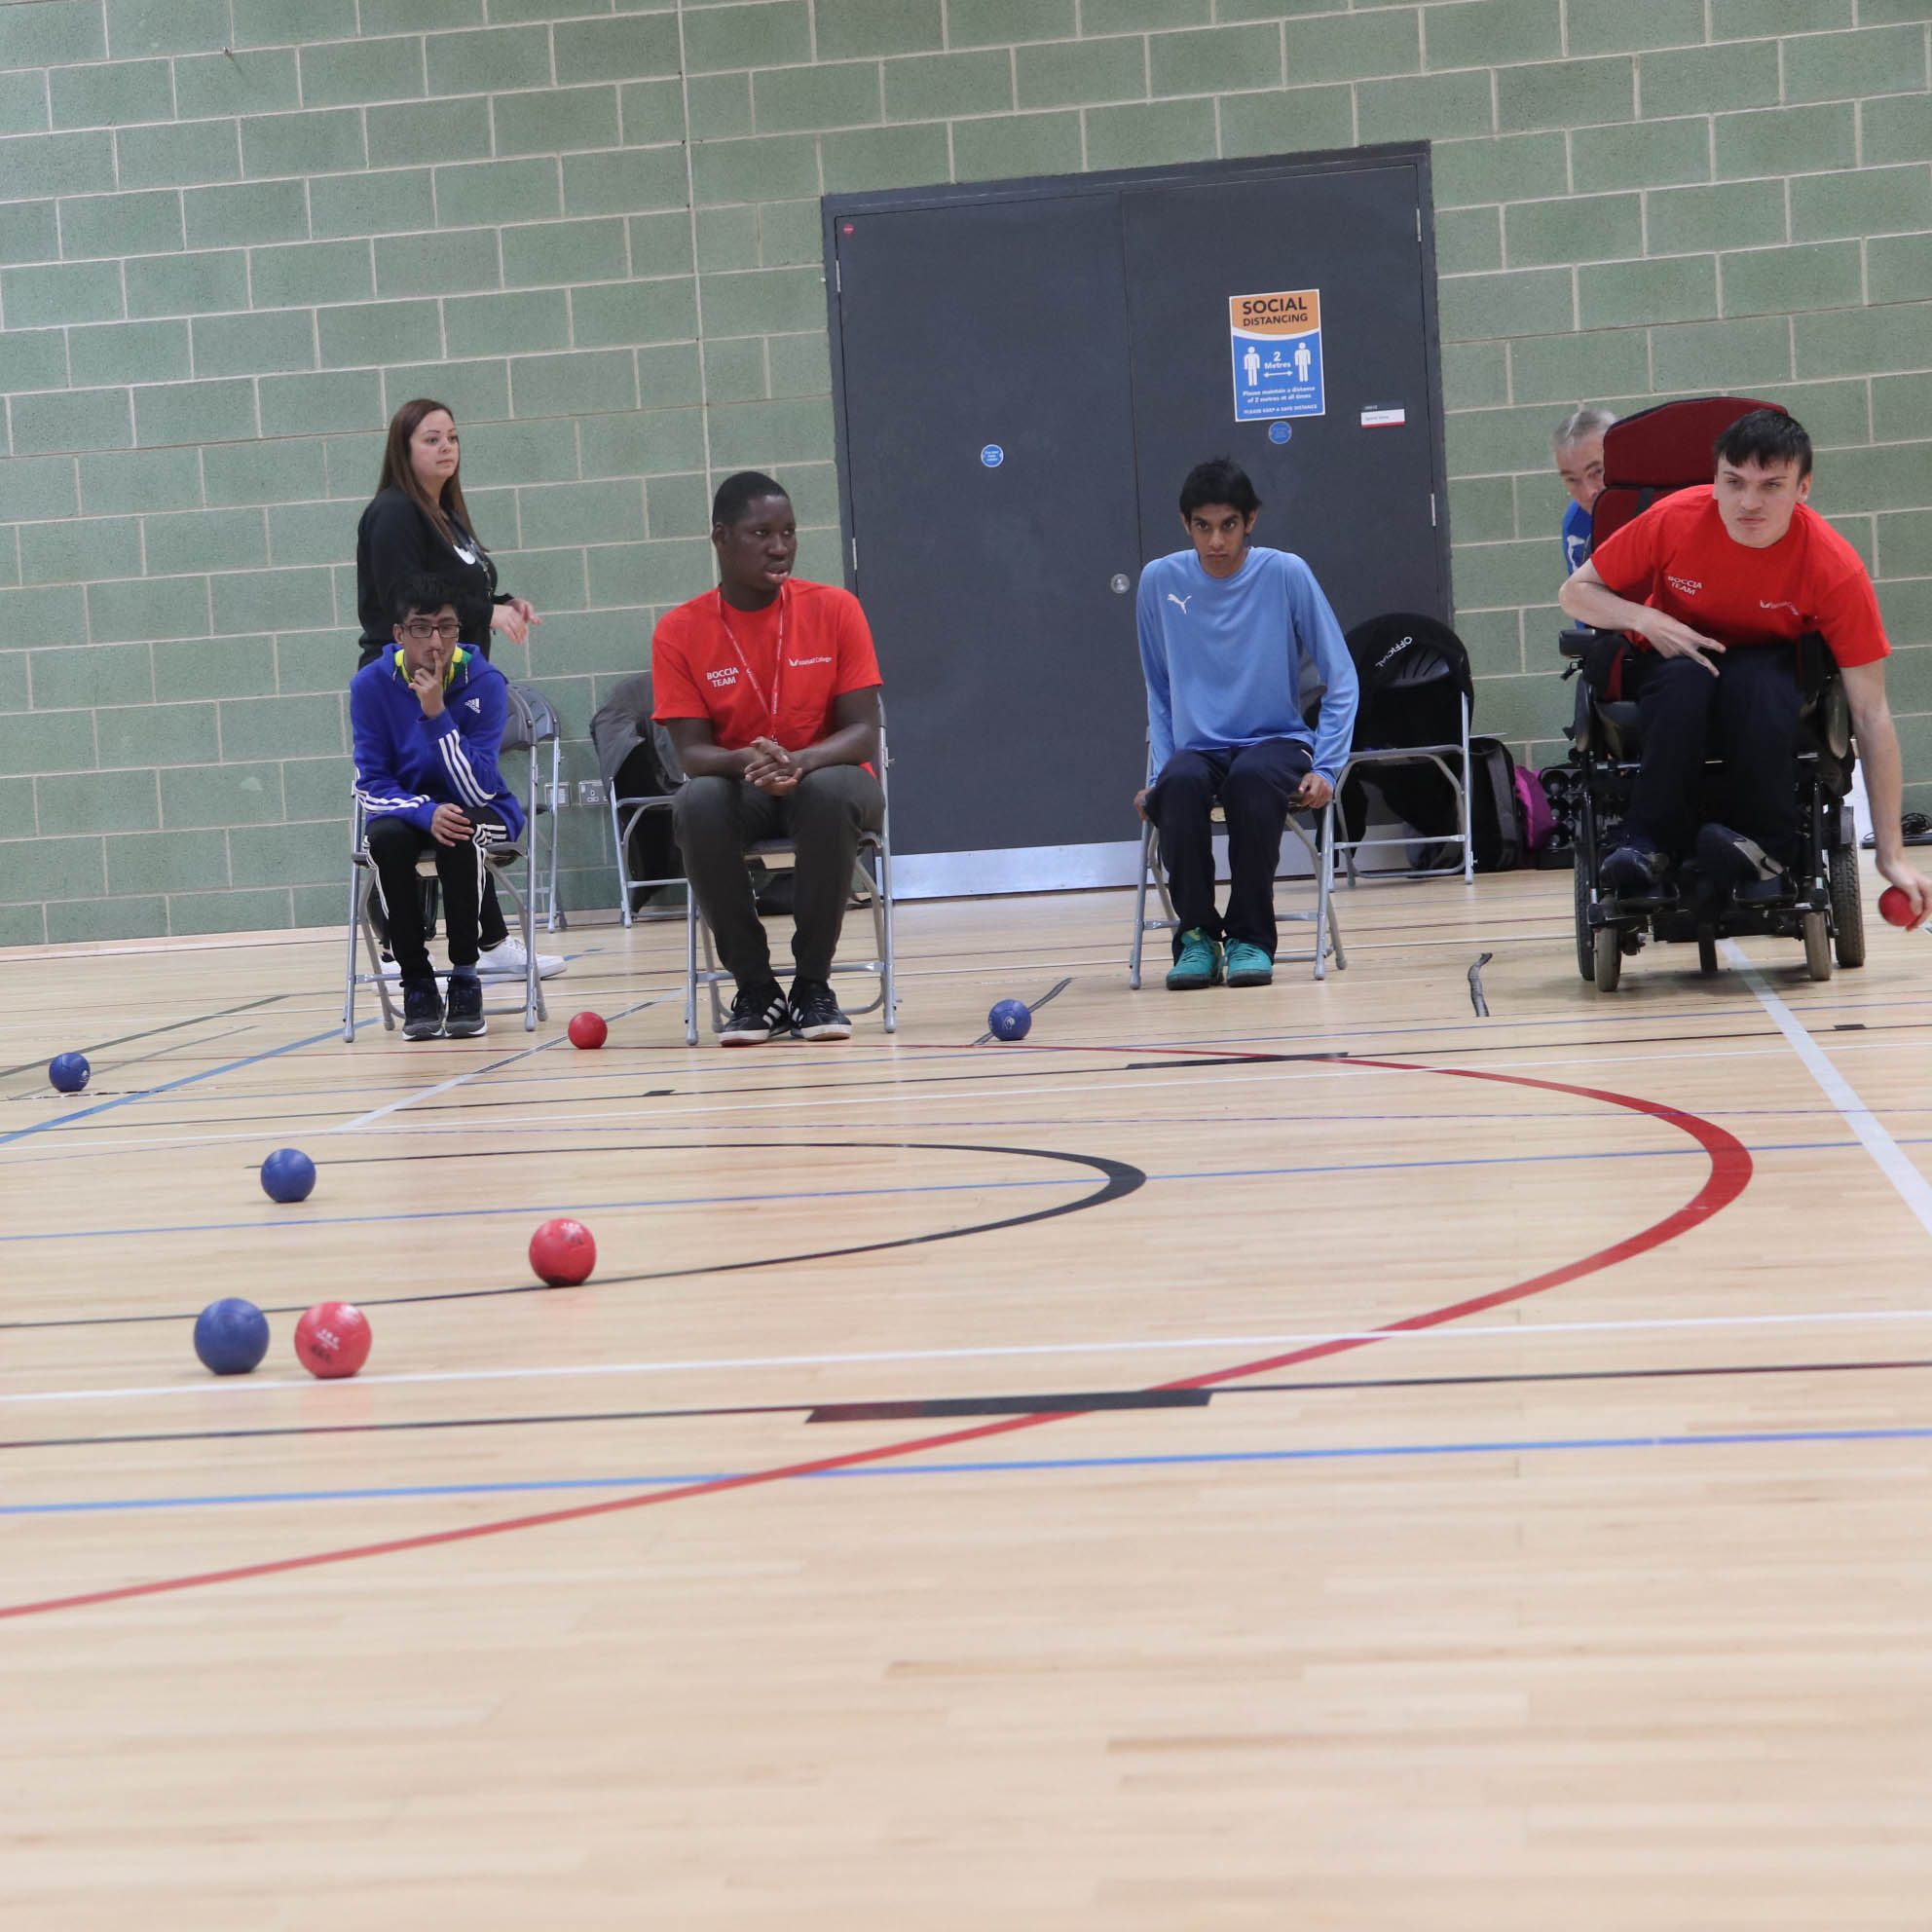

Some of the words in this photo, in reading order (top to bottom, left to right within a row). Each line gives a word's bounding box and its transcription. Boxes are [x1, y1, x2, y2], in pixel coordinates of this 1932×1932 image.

[1242, 297, 1308, 315] SOCIAL
[1243, 313, 1308, 327] DISTANCING
[1273, 351, 1282, 362] 2
[1667, 576, 1703, 589] BOCCIA
[1671, 582, 1696, 596] TEAM
[1375, 636, 1413, 668] OFFICIAL
[706, 667, 739, 681] BOCCIA
[712, 676, 737, 687] TEAM
